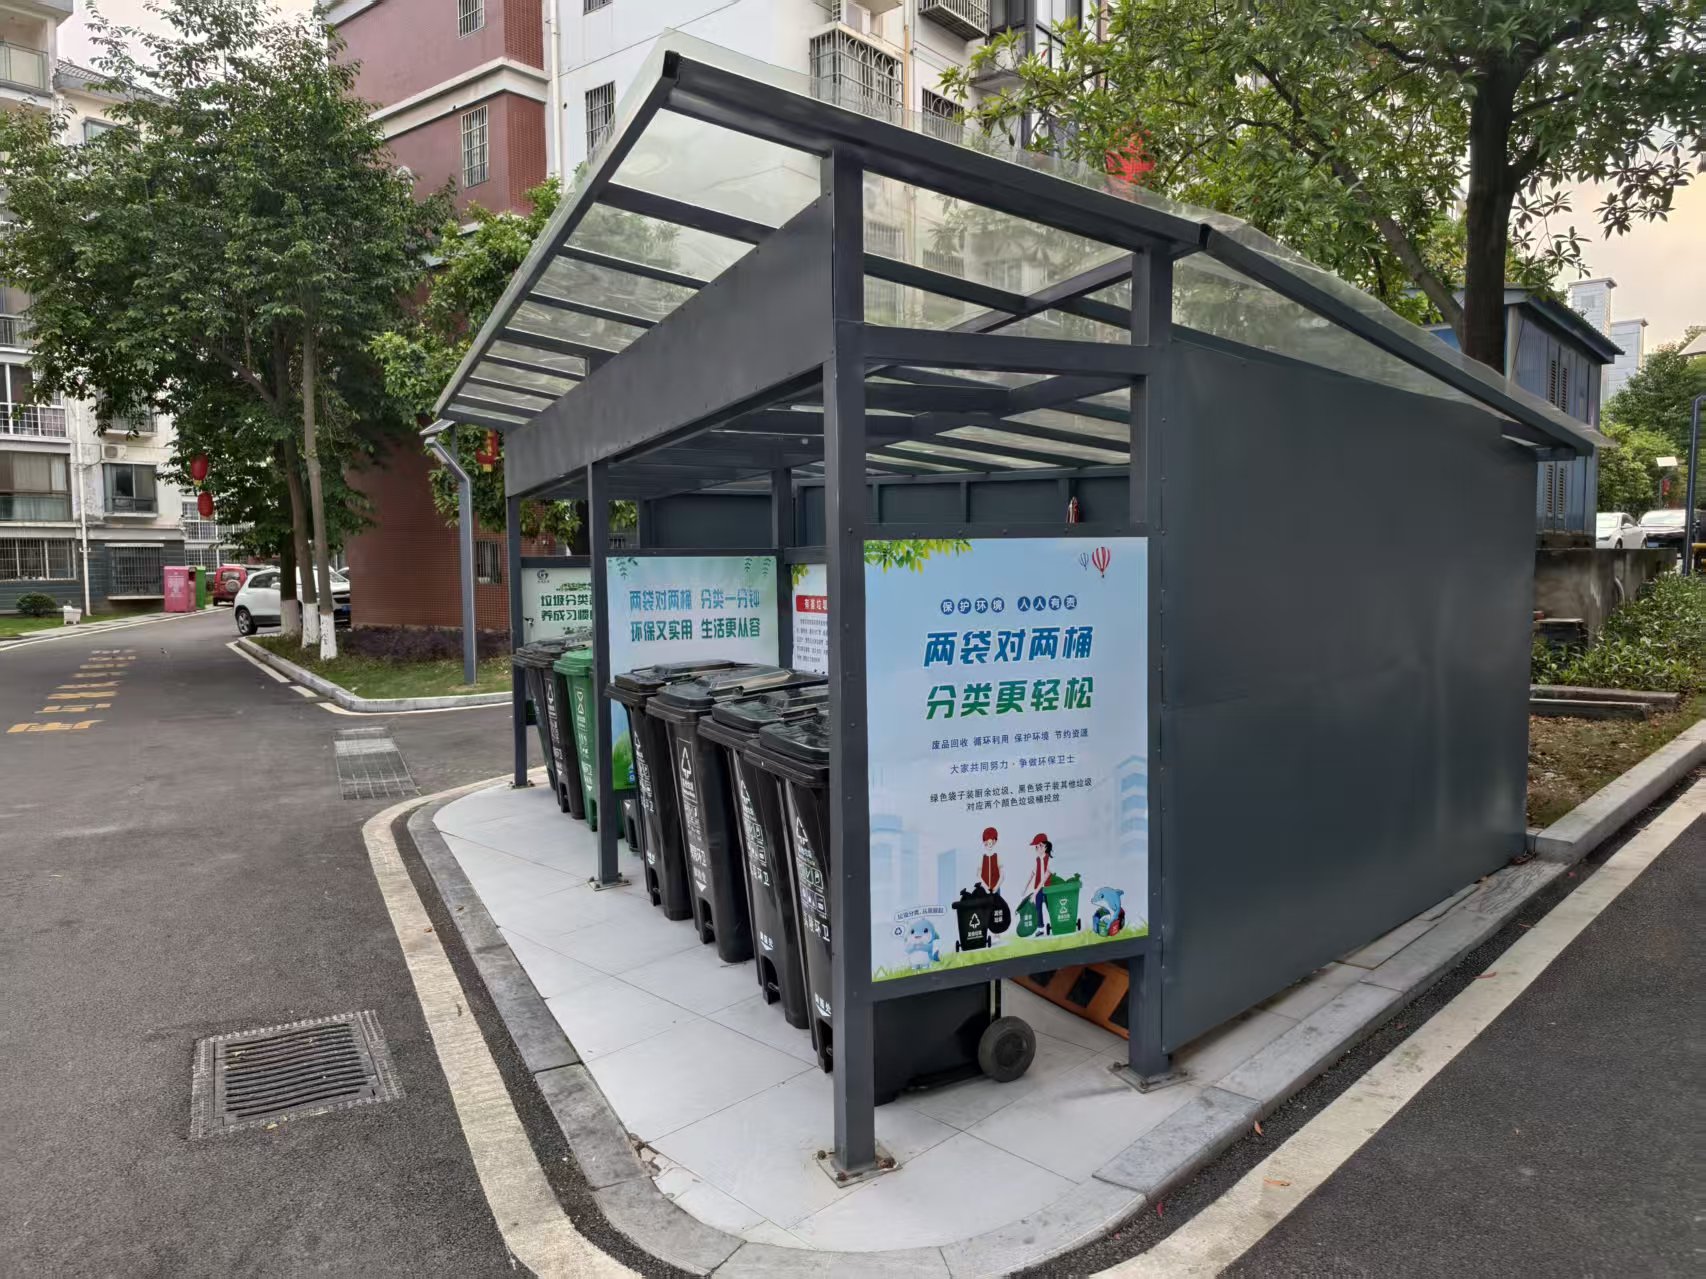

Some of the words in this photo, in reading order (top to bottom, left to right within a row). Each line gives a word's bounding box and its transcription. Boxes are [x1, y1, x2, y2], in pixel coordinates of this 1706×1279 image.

[629, 588, 692, 611] 两袋对两桶
[701, 588, 760, 610] 分类一分钟
[942, 597, 1004, 615] 保护环境
[1018, 595, 1077, 611] 人人有责
[630, 620, 692, 642] 环保又实用
[701, 617, 760, 639] 生活更从容
[923, 626, 1093, 667] 两袋对两桶
[925, 677, 1094, 720] 分类更轻松
[932, 738, 968, 750] 废品回收
[973, 735, 1009, 746] 循环利用
[1014, 731, 1049, 743] 保护环境
[1054, 728, 1088, 740] 节约资源
[966, 793, 1060, 812] 对应两个颜色垃圾桶投放
